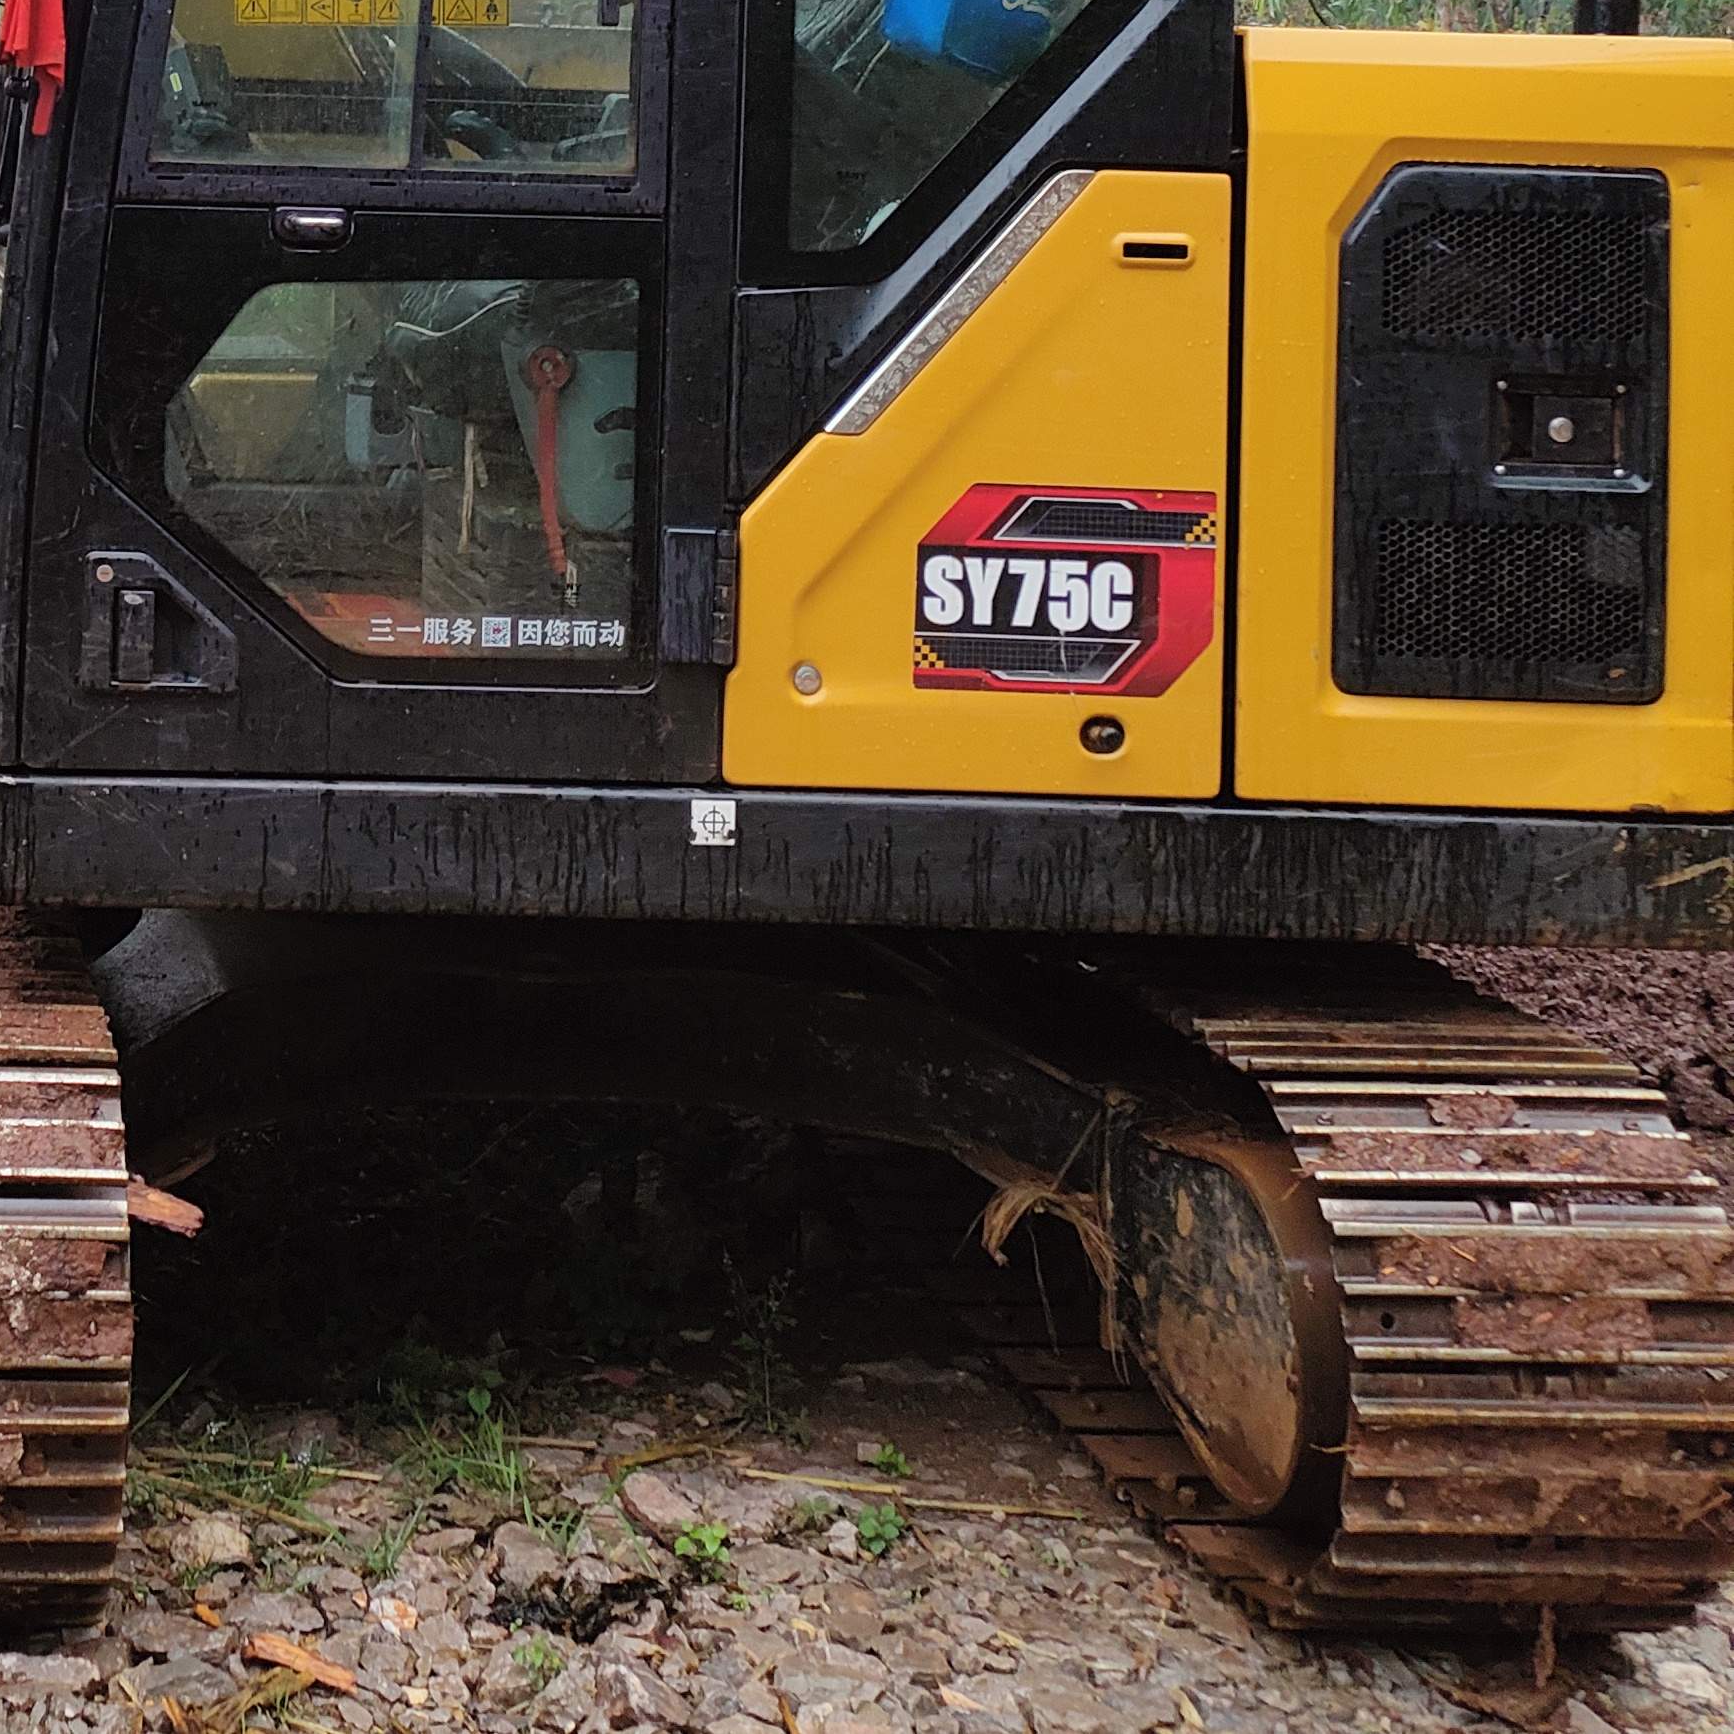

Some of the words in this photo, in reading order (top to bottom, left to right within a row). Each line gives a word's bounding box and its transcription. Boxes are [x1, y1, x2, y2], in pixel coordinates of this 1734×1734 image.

[923, 554, 1134, 632] SY75C
[367, 617, 477, 645] 三一服务
[517, 619, 626, 647] 因您而动
